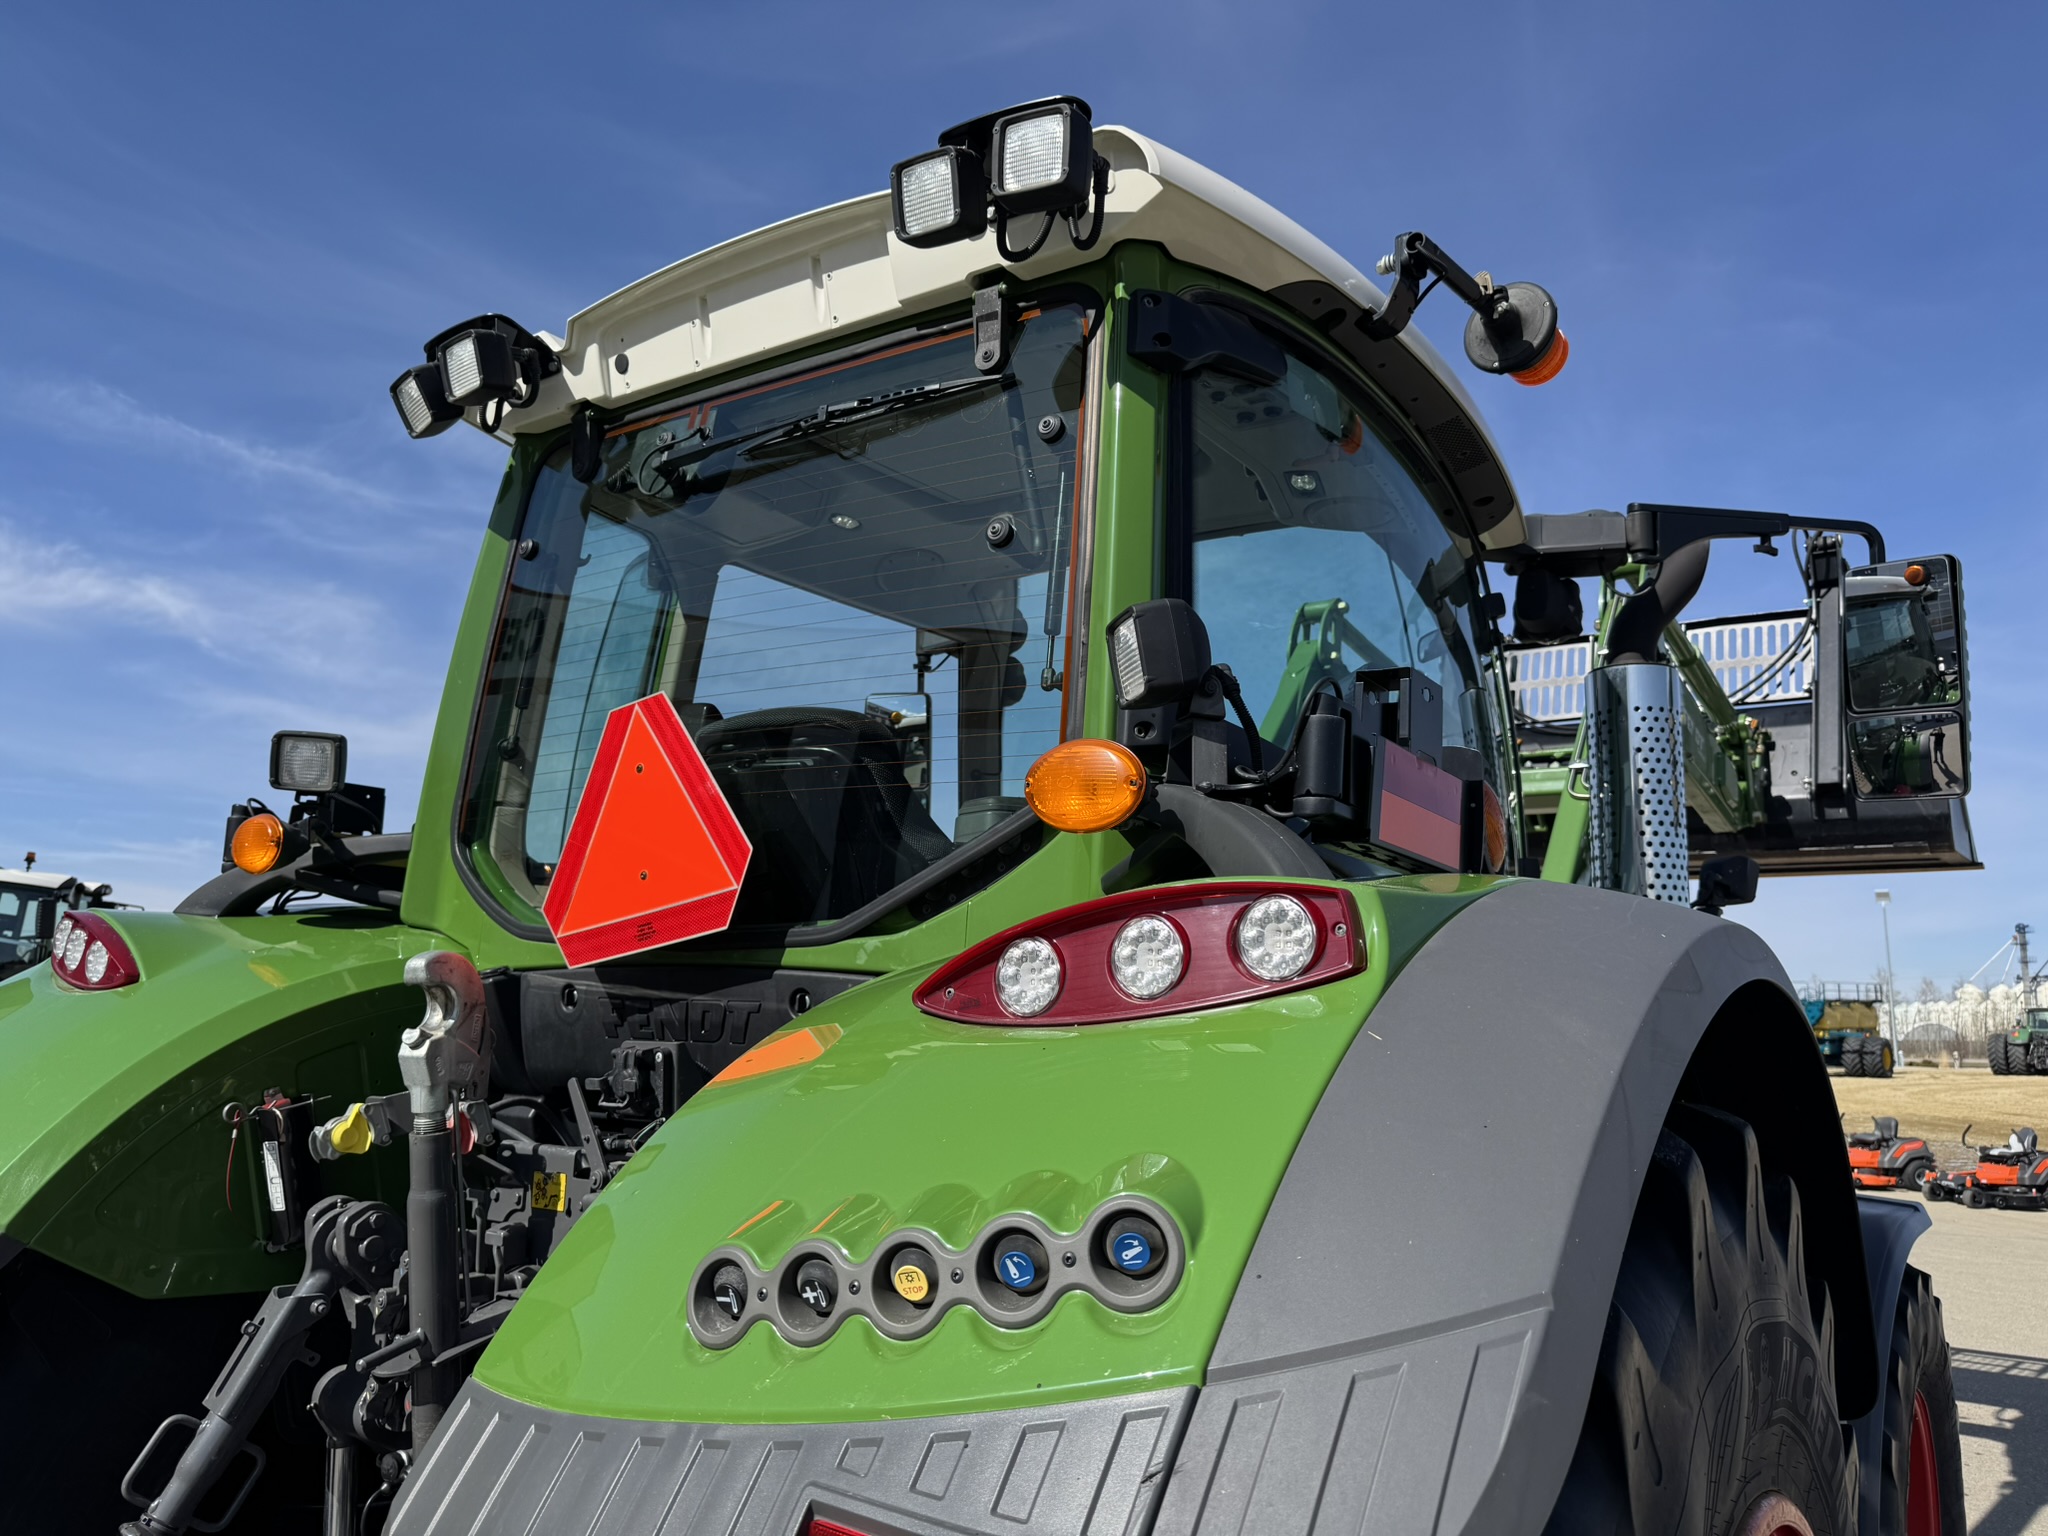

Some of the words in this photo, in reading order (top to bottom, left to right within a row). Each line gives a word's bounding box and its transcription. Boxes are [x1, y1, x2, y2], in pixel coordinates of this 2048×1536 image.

[598, 997, 762, 1045] FENDT
[902, 1286, 924, 1296] STOP
[1775, 1336, 1848, 1529] MICHELIN
